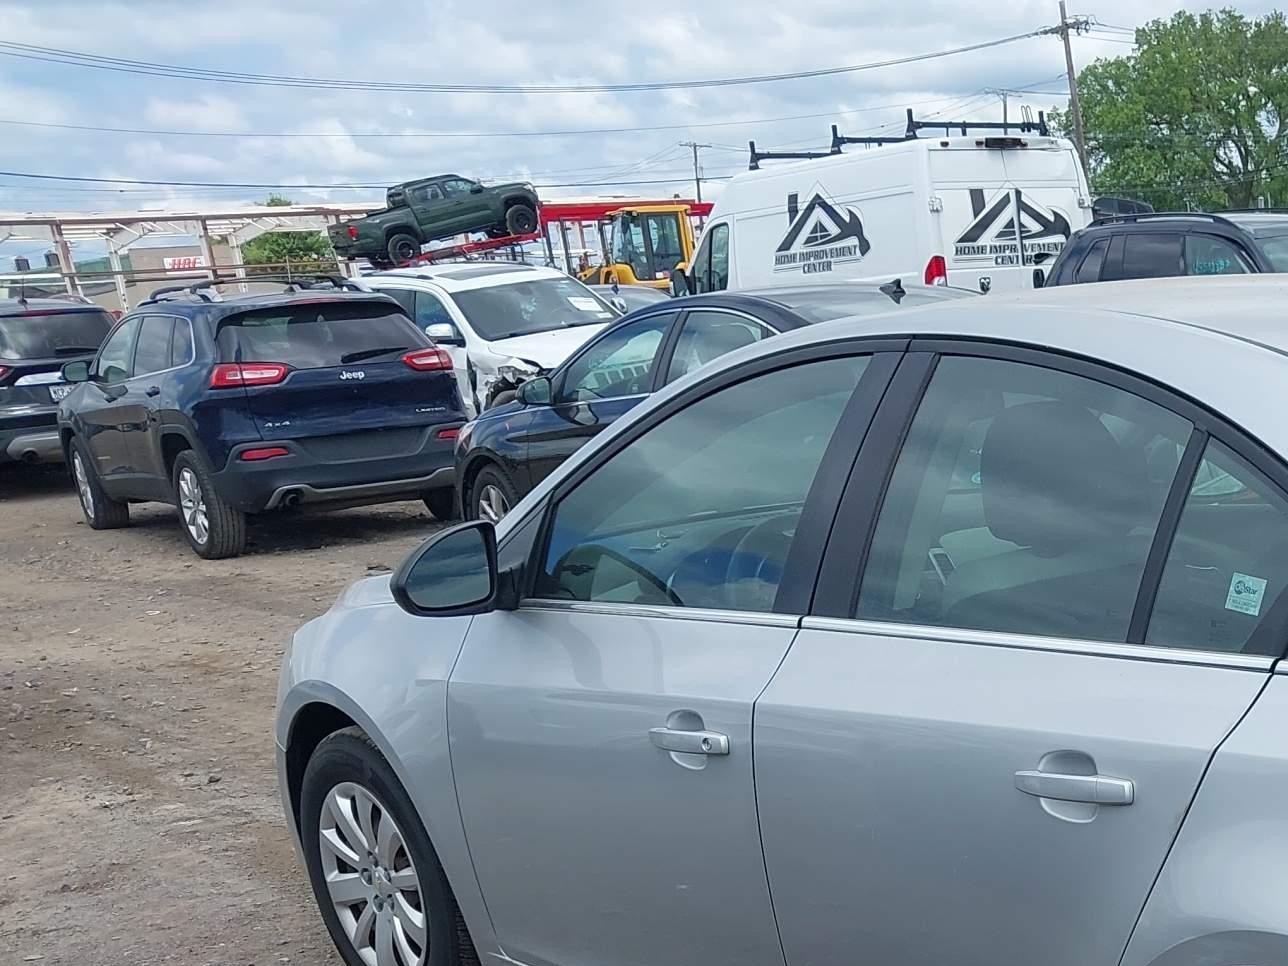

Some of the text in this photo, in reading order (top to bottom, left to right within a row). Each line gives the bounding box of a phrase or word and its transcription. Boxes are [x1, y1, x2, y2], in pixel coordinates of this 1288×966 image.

[775, 244, 858, 265] HOME IMPROVEMENT
[954, 241, 1065, 256] HOME IMPRVEMENT
[994, 253, 1033, 265] CENTR
[802, 260, 833, 274] CENTER
[340, 370, 365, 380] Jeep
